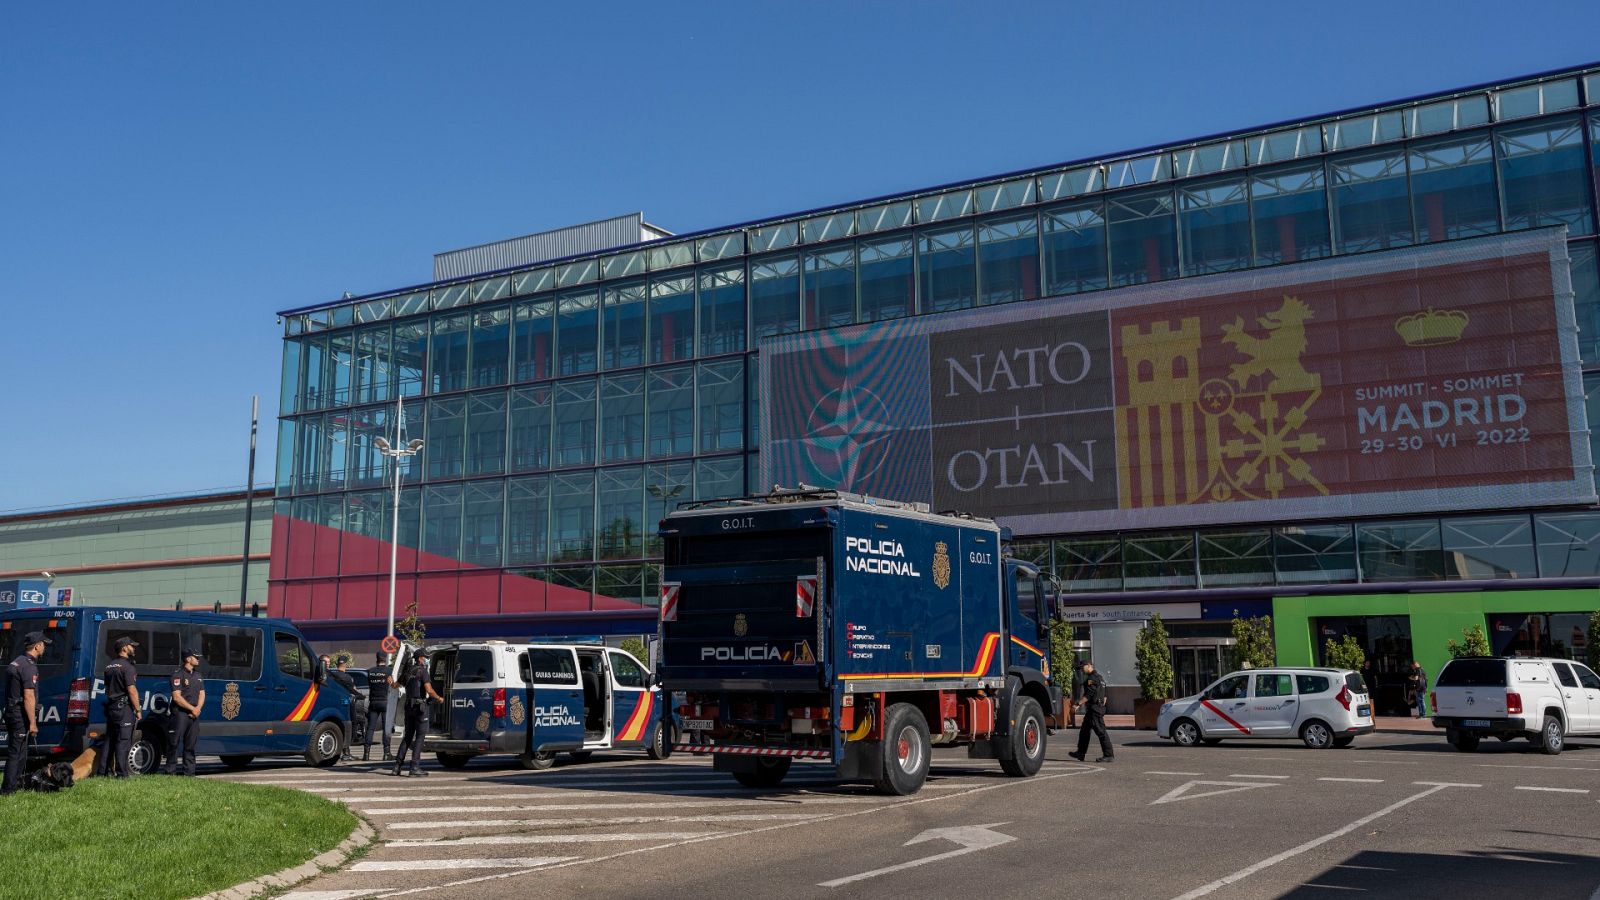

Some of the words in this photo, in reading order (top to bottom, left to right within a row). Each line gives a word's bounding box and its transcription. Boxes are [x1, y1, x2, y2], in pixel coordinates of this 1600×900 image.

[945, 342, 1091, 397] NATO
[1355, 382, 1424, 400] SUMMIT
[1443, 373, 1525, 393] SOMMET
[1357, 393, 1527, 434] MADRID
[1361, 435, 1423, 454] 29-30
[1435, 432, 1457, 448] VI
[1477, 427, 1530, 445] 2022
[947, 440, 1097, 491] OTAN
[721, 517, 755, 529] G.O.I.T.
[846, 536, 904, 557] POLICÍA
[846, 556, 920, 577] NACIONAL
[701, 643, 782, 660] POLICÍA
